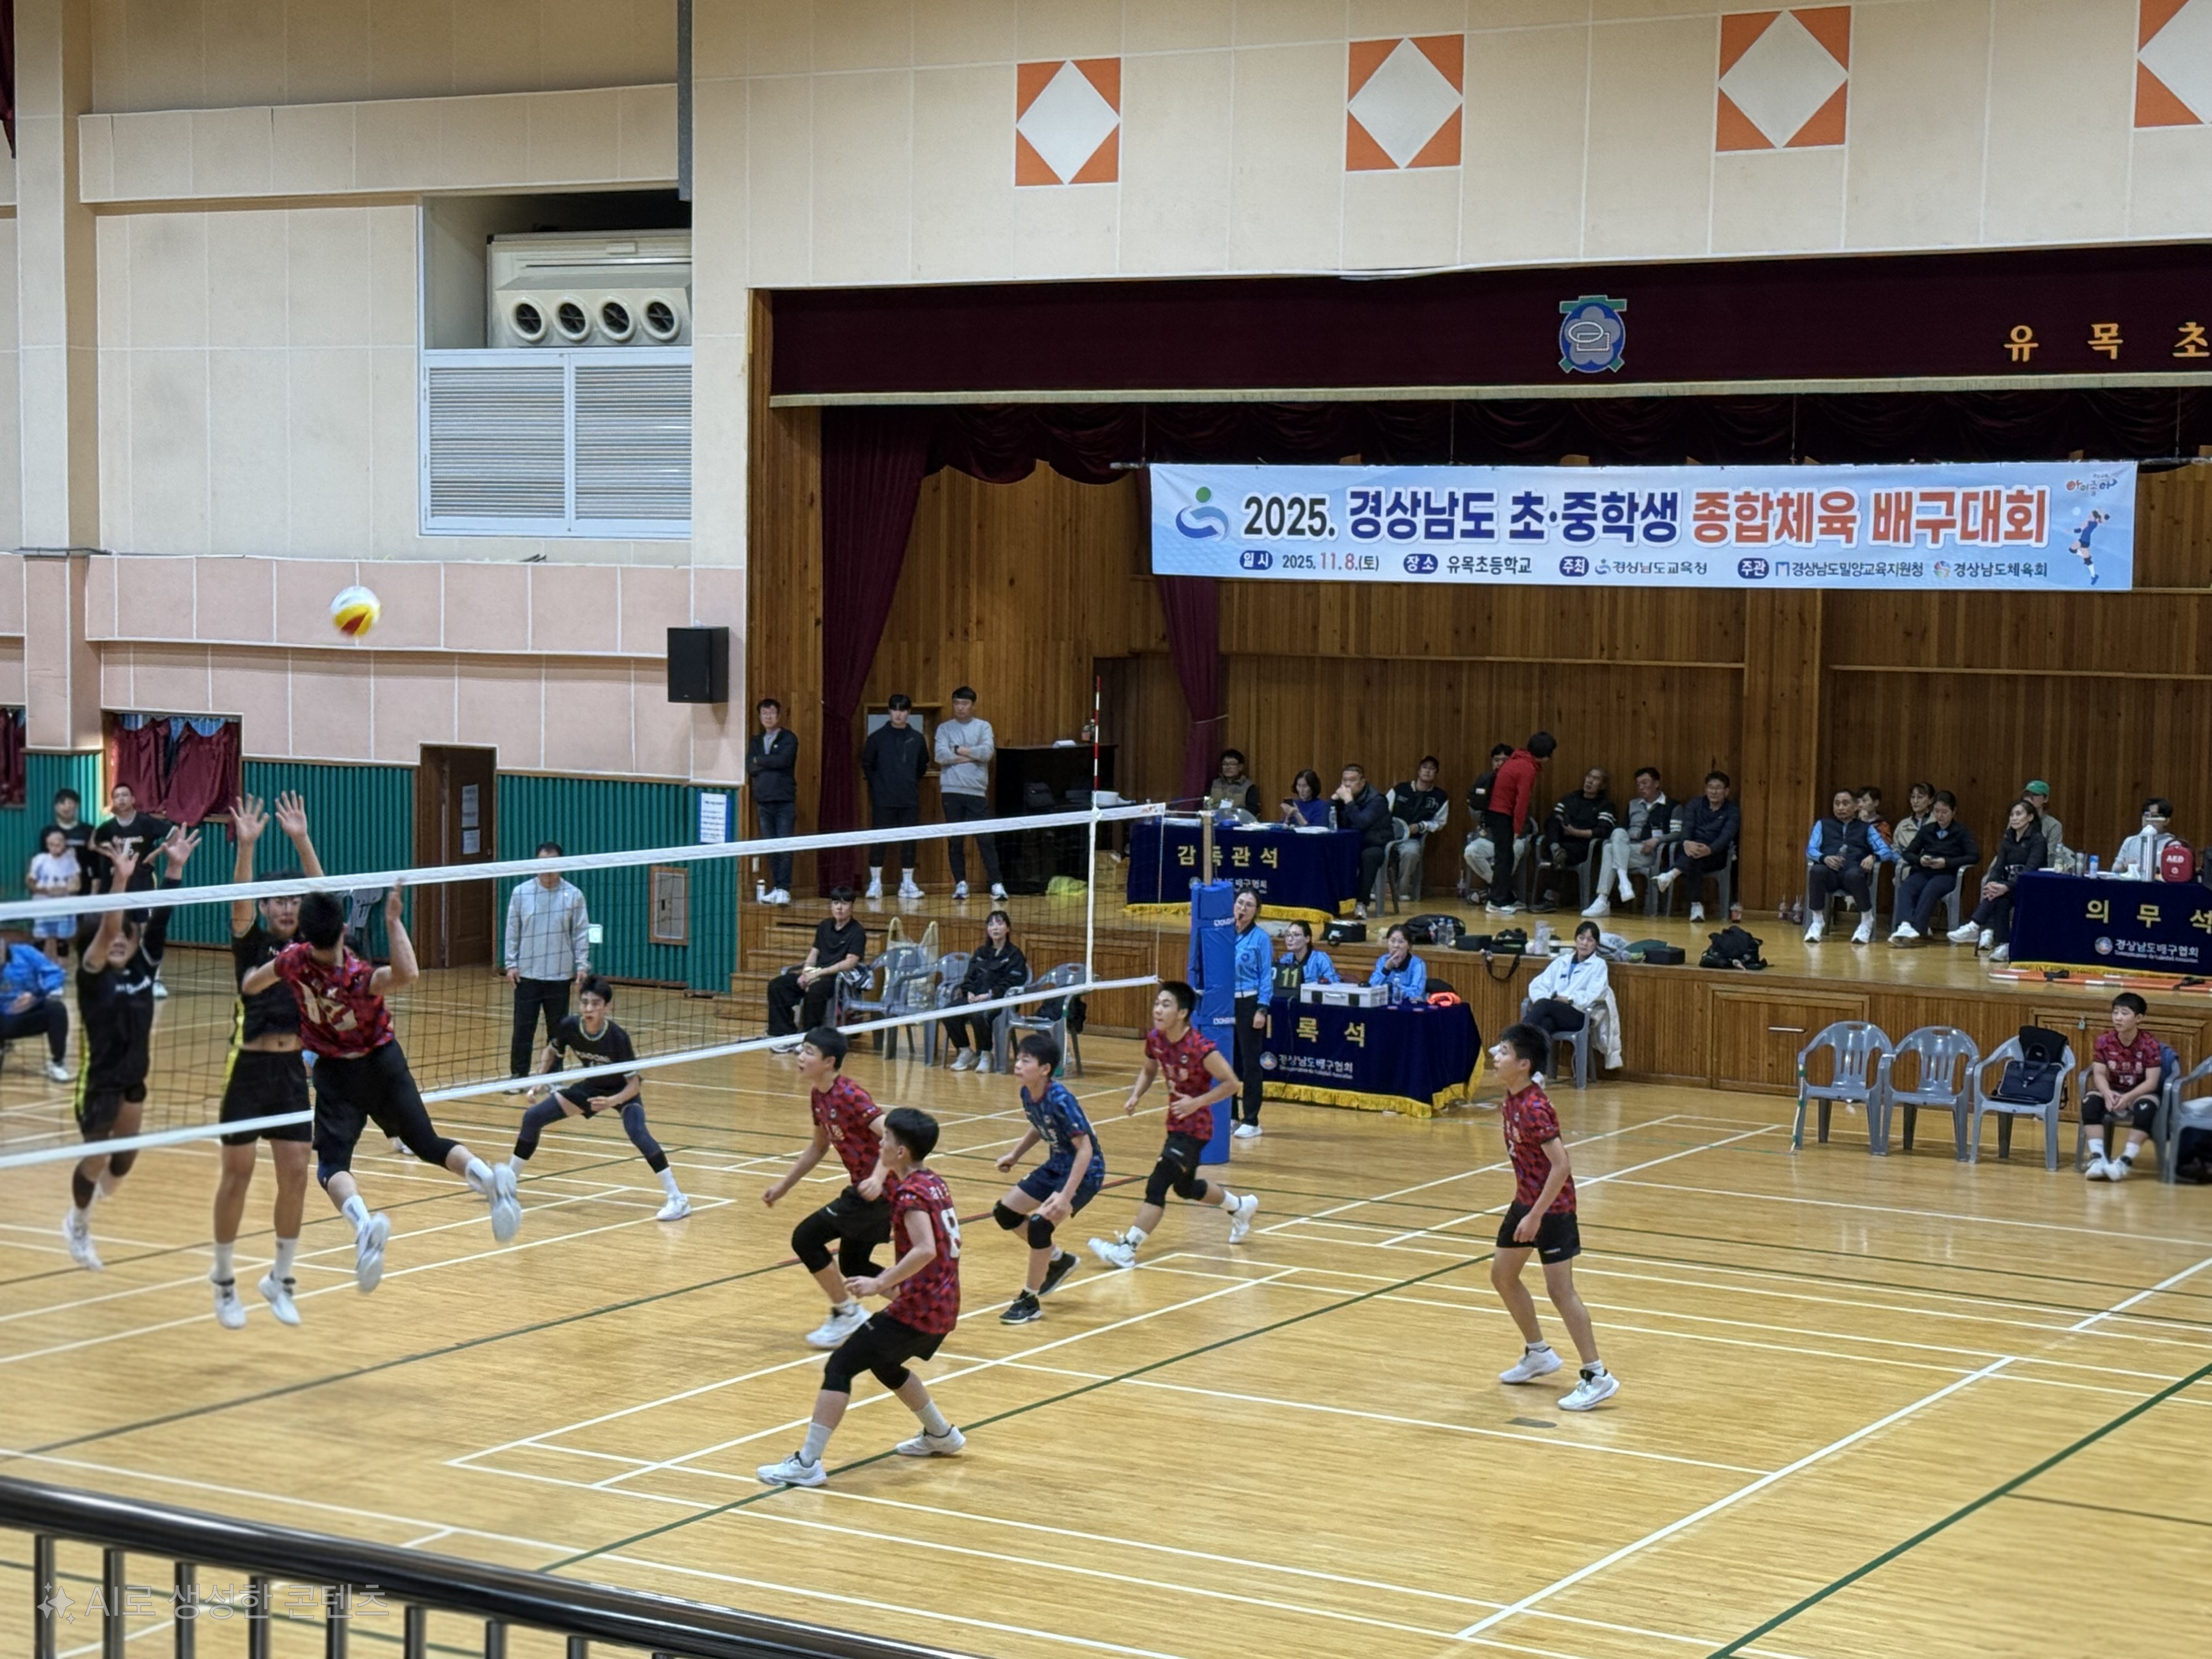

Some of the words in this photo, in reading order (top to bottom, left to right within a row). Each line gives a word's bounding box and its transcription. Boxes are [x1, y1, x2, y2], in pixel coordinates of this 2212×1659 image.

[1244, 496, 1335, 536] 2025.
[1349, 490, 1495, 540] 경상남도
[1509, 491, 1677, 543] 초·중학생
[1692, 491, 1855, 544] 종합체육
[1874, 489, 2046, 544] 배구대회
[1446, 556, 1532, 575] 유목초등학교
[1741, 560, 1766, 576] 주관
[1792, 561, 1923, 577] 경상남도밀양교육지원청
[1953, 561, 2047, 577] 경상남도체육회
[2166, 855, 2184, 863] AED
[1281, 967, 1298, 988] 11
